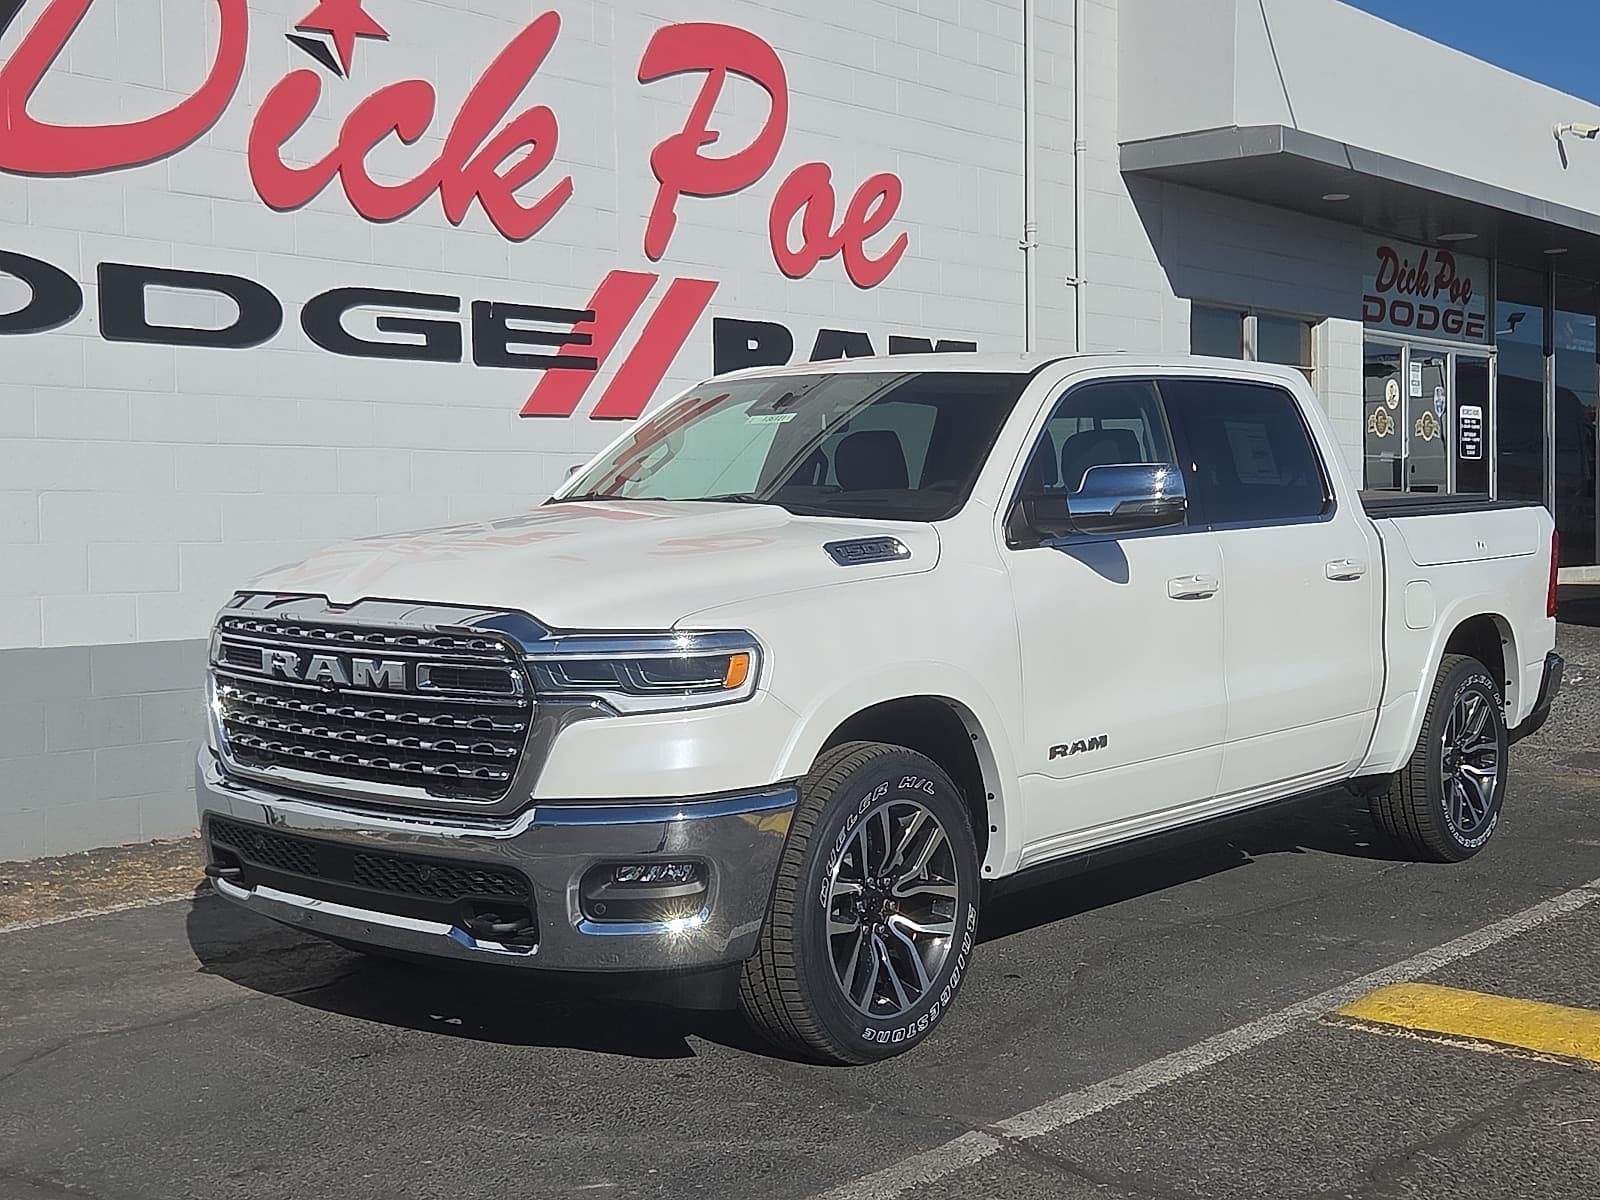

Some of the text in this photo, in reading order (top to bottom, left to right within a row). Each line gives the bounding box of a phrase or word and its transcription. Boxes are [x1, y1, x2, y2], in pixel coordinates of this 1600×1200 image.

[0, 0, 908, 289] Dick Poe
[1376, 246, 1473, 305] Dick Poe
[1362, 294, 1486, 338] DODGE
[261, 647, 408, 691] RAM
[1048, 734, 1107, 760] RAM
[819, 776, 936, 908] DUELER H/L
[862, 903, 977, 1043] BRIDGESTONE
